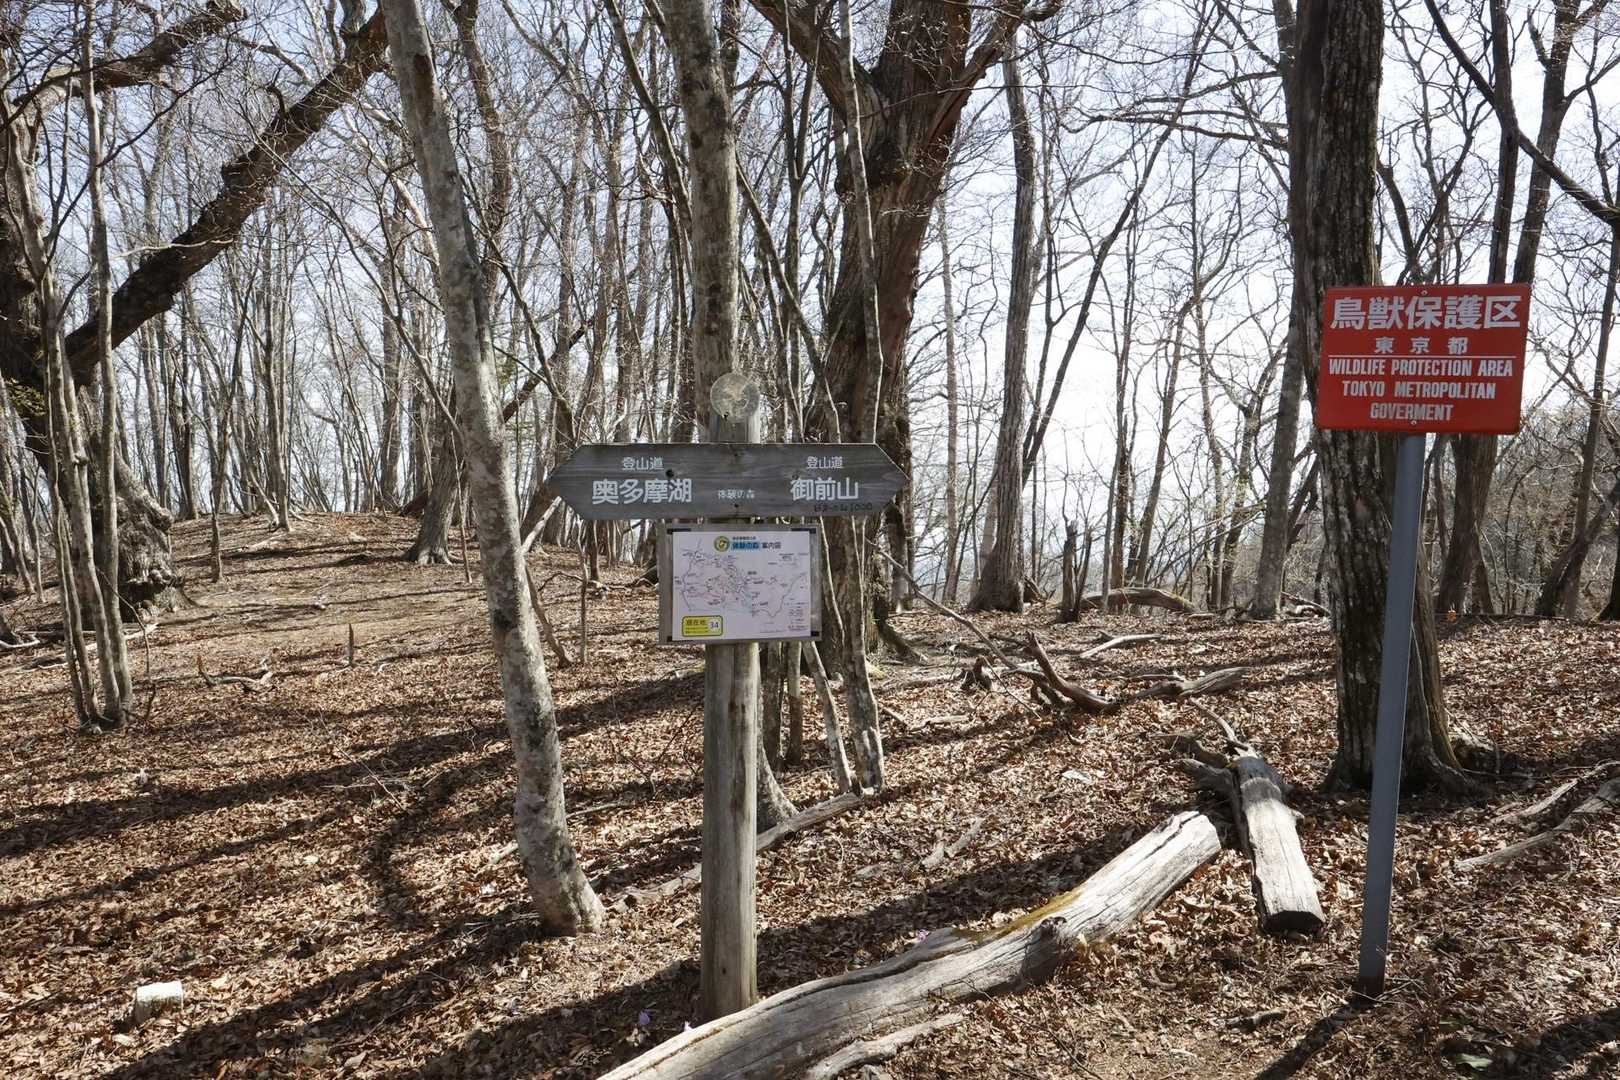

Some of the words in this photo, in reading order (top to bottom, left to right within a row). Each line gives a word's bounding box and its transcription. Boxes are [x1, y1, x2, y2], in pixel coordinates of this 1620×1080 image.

[1330, 295, 1521, 330] 鳥獣保護区
[1328, 358, 1386, 375] WILDLIFE
[1390, 359, 1472, 377] PROTECTION
[1477, 359, 1513, 377] AREA
[1342, 380, 1385, 397] TOKYO
[1394, 381, 1496, 399] METROPOLITAN
[622, 456, 664, 471] 登山道
[806, 456, 844, 469] 登山道
[592, 478, 692, 505] 奥多摩湖
[790, 477, 859, 501] 御前山
